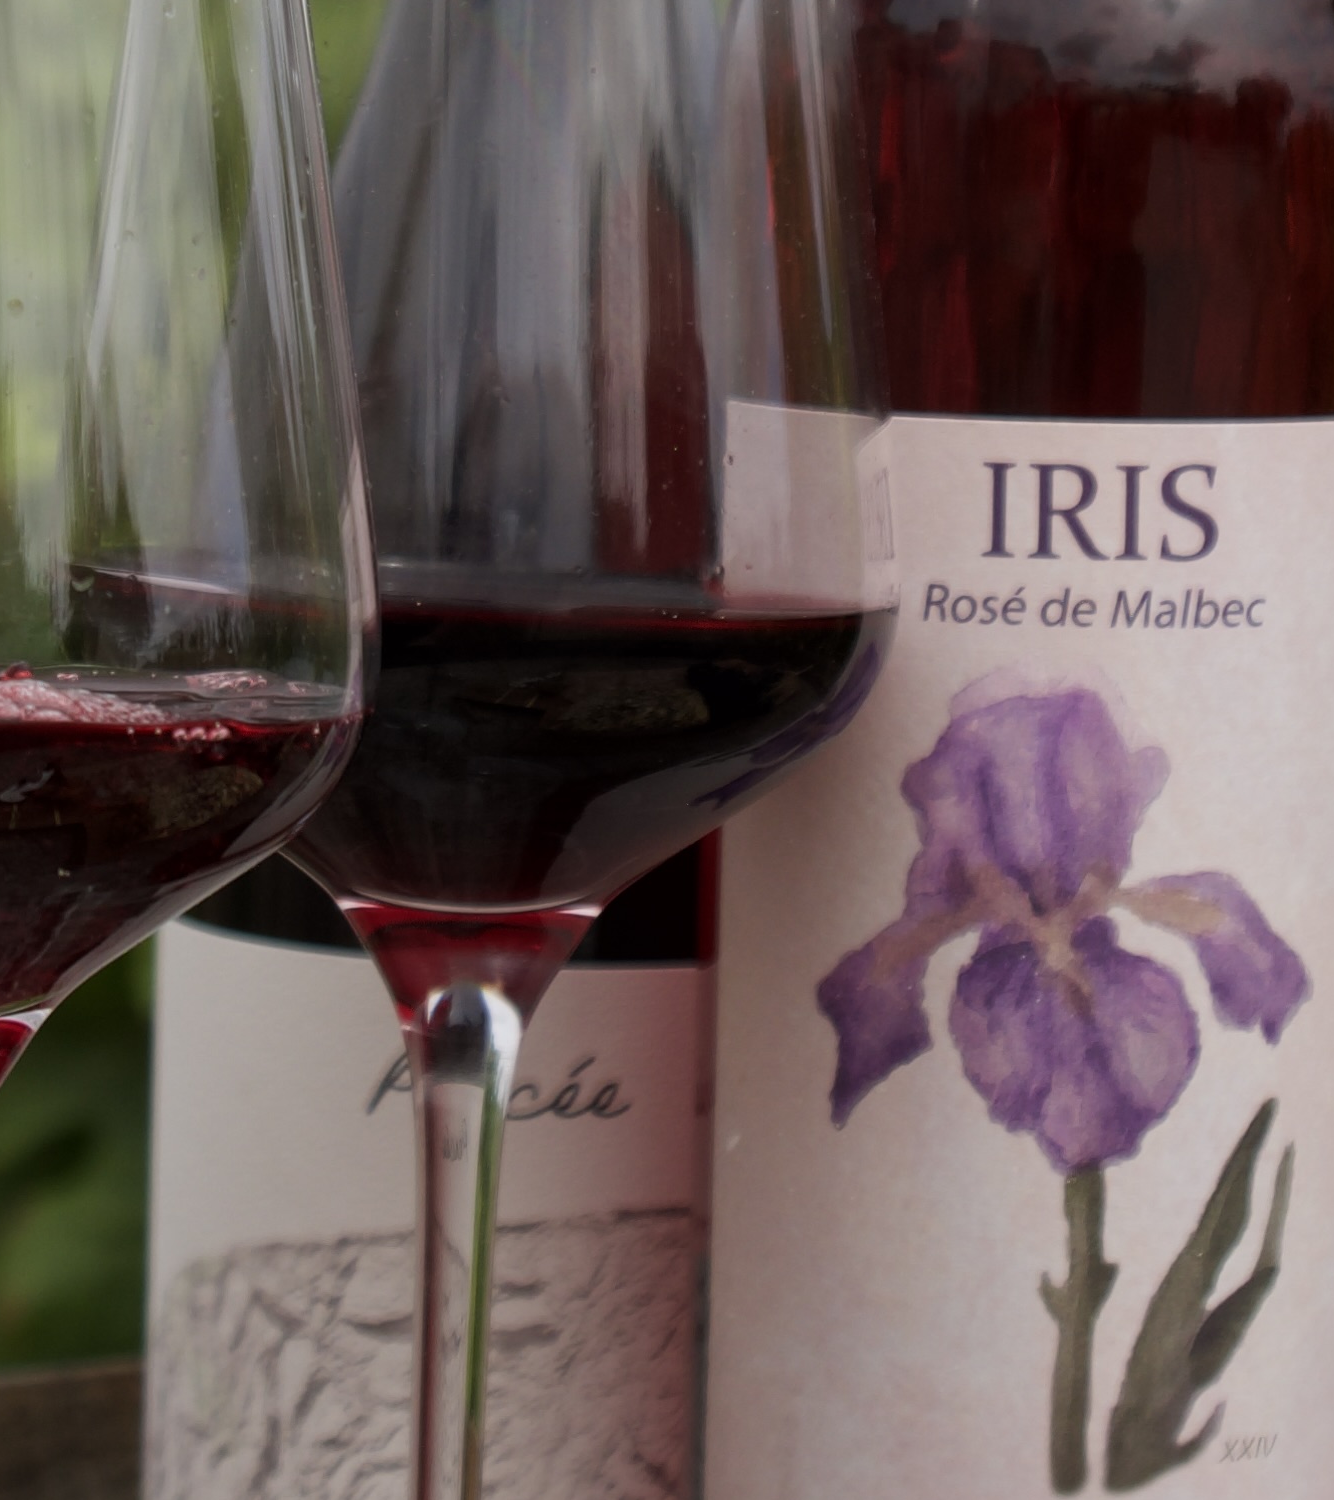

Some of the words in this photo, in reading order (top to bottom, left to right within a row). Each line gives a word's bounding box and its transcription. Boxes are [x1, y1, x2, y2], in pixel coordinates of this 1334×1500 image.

[980, 461, 1220, 563] IRIS
[922, 581, 1028, 626] Rosé
[1040, 588, 1097, 628] de
[1110, 589, 1266, 630] Malbec
